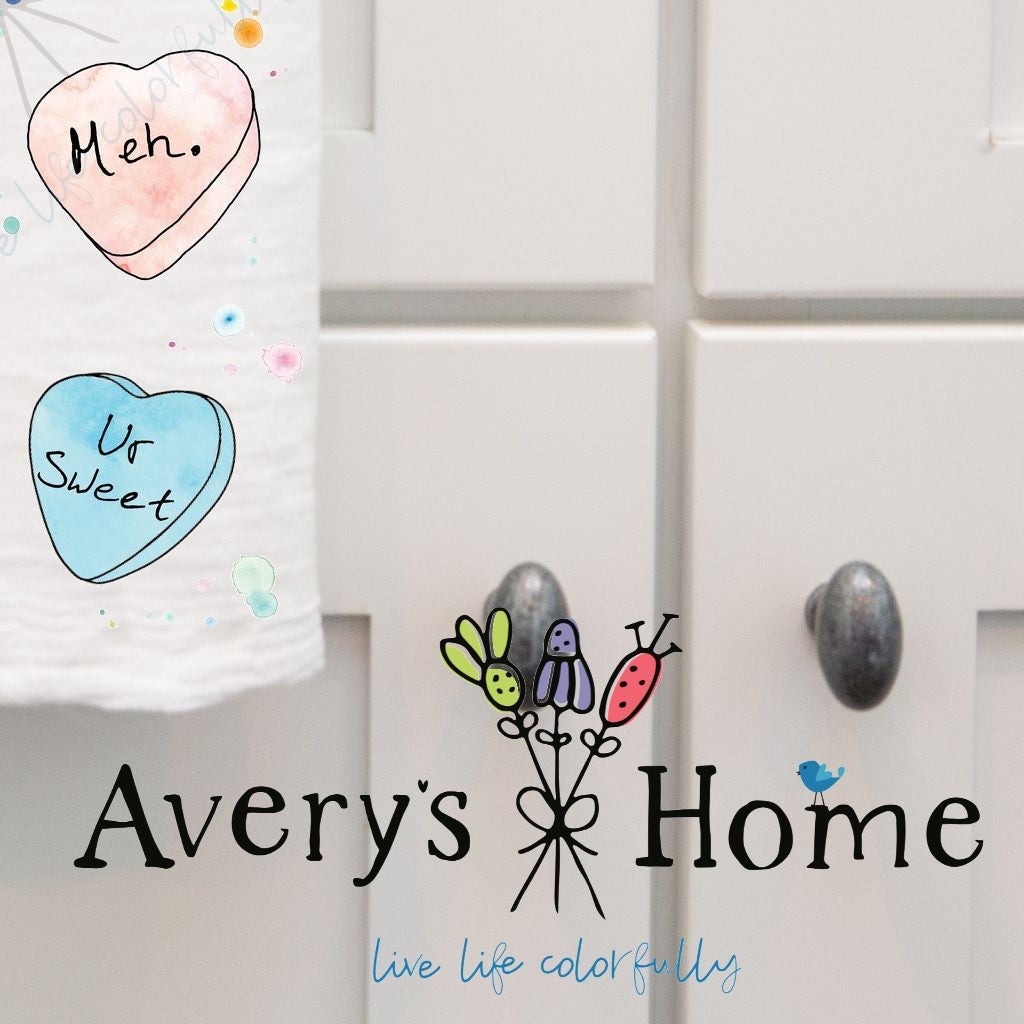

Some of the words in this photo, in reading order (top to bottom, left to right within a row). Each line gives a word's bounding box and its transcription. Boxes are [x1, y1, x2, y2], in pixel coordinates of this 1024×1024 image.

[69, 120, 201, 177] Meh.
[97, 414, 155, 465] Ur
[37, 450, 175, 522] Sweet
